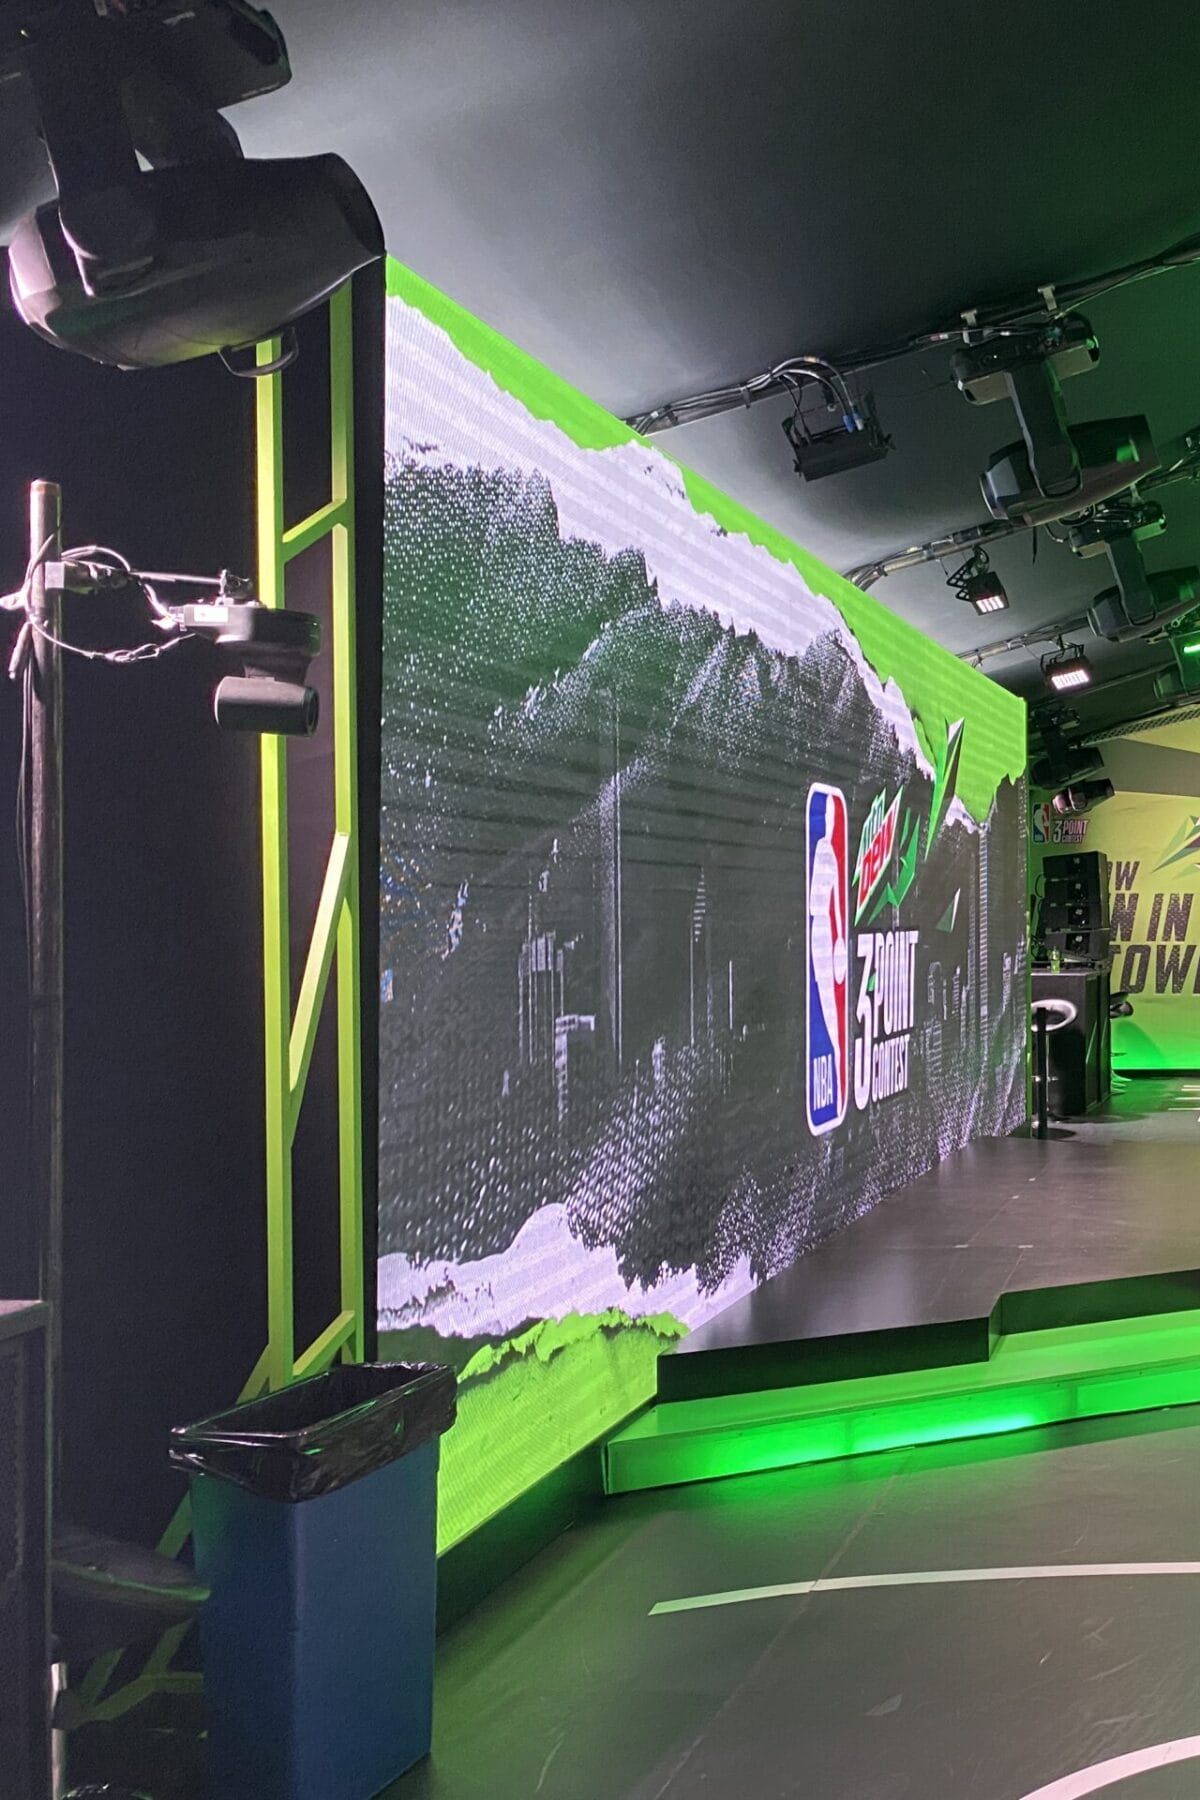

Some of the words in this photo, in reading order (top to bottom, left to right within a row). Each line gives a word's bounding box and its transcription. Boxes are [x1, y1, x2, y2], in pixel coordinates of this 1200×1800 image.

[1063, 820, 1089, 835] POINT
[1109, 893, 1139, 942] N
[1147, 893, 1194, 942] IN
[854, 933, 874, 1110] 3
[873, 930, 919, 1039] POINT
[813, 1053, 834, 1112] NBA
[872, 1034, 910, 1103] CONTEST
